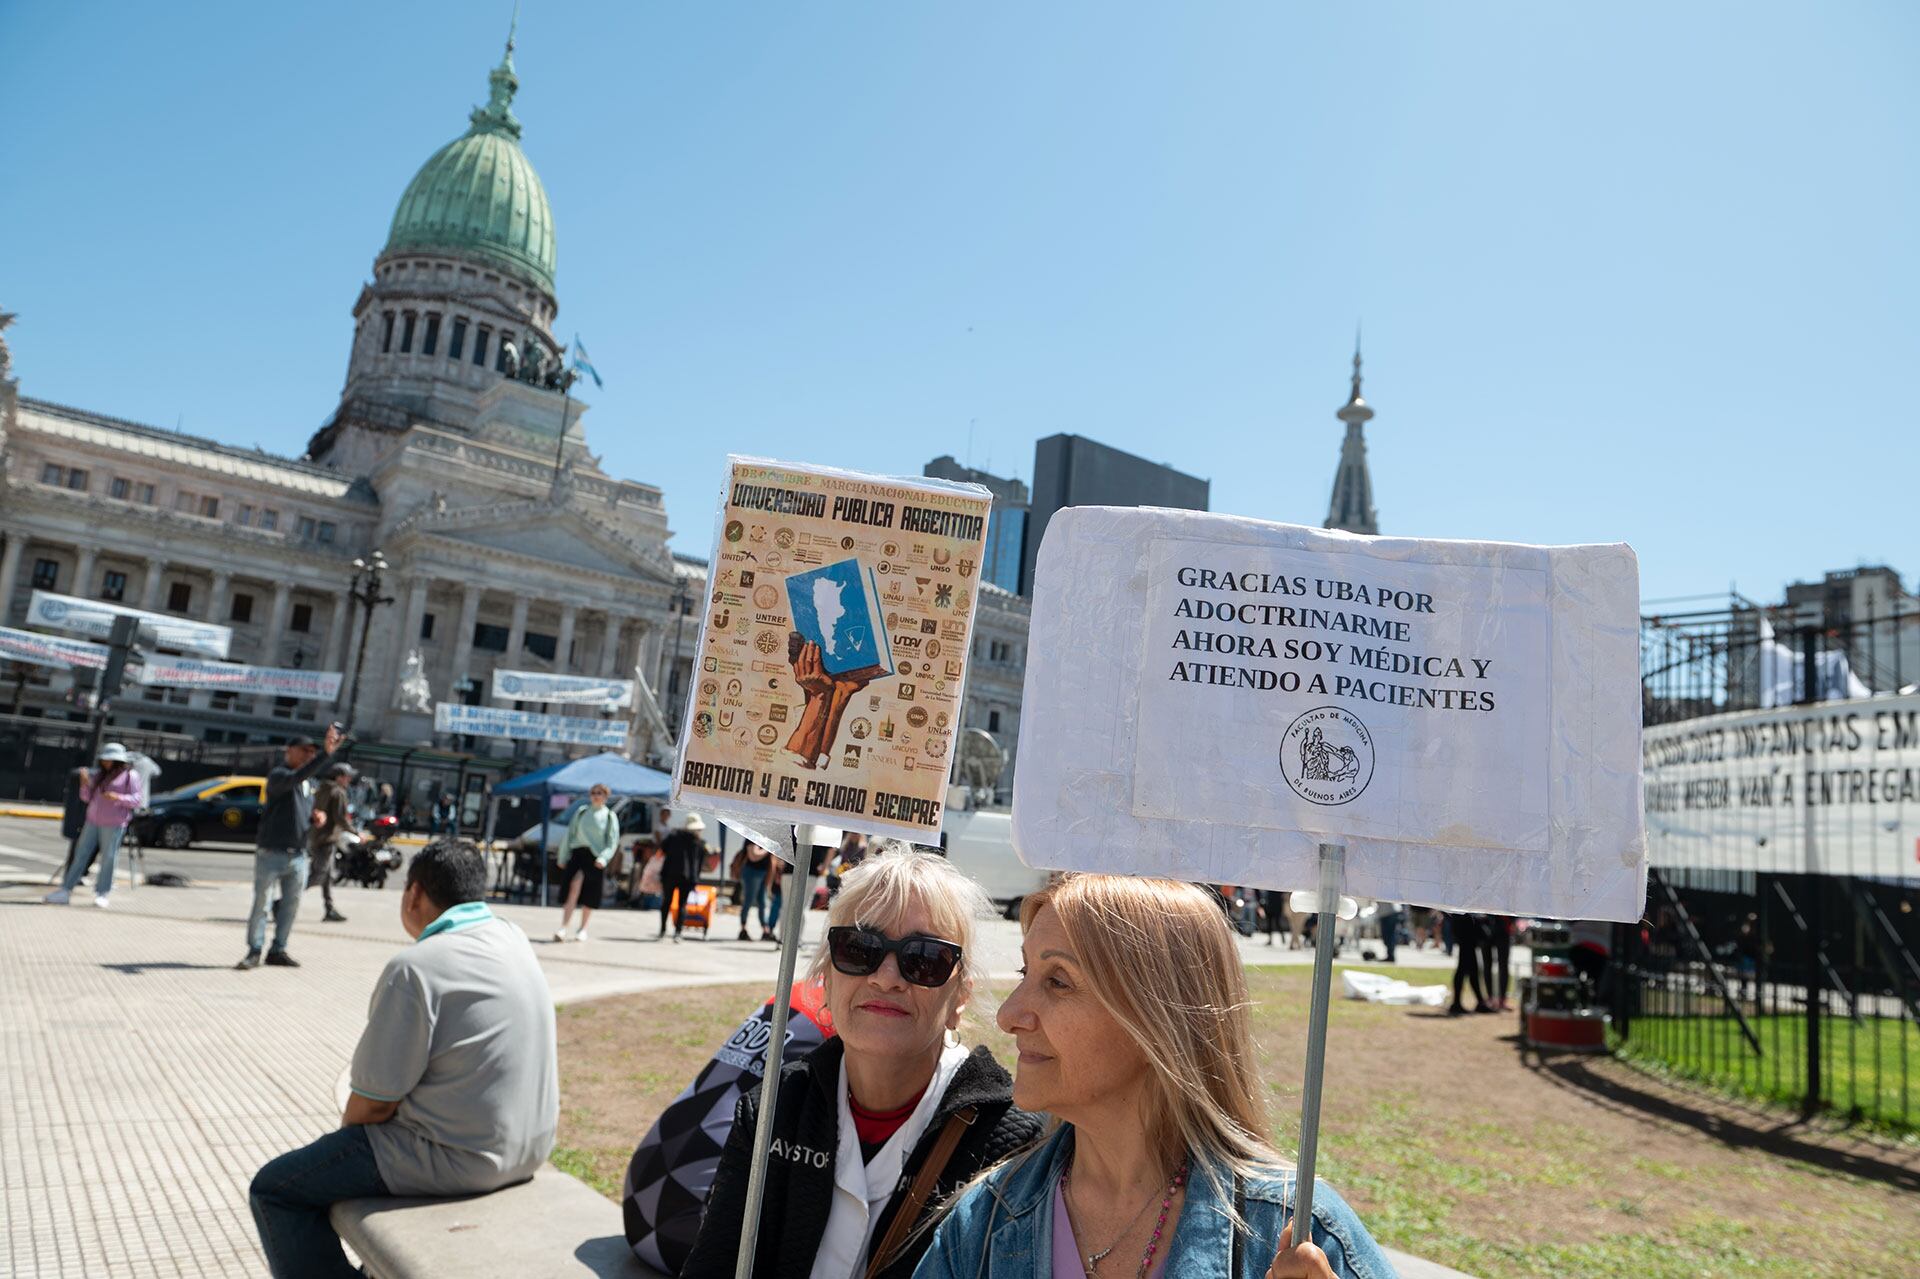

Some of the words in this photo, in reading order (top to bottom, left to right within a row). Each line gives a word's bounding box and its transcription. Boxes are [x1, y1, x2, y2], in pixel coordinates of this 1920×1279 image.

[821, 478, 867, 494] MARCHA
[870, 484, 928, 504] NACIONAL
[731, 484, 827, 518] UNIVERSIDAD
[832, 496, 895, 528] PUBLICA
[900, 506, 984, 541] ARGENTINA
[1177, 567, 1307, 596] GRACIAS
[1314, 579, 1372, 606] UBA
[1377, 588, 1436, 614] POR
[755, 613, 787, 624] UNTREF
[952, 609, 969, 618] UNC
[1173, 598, 1411, 643] ADOCTRINARME
[893, 634, 922, 648] UNDAV
[1171, 629, 1278, 658] AHORA
[1284, 639, 1343, 663] SOY
[1349, 645, 1465, 678] MÉDICA
[1471, 658, 1492, 679] Y
[1169, 661, 1301, 692] ATIENDO
[1306, 673, 1328, 695] A
[1334, 675, 1495, 712] PACIENTES
[1291, 713, 1325, 738] FACULTAD
[1329, 712, 1340, 720] DE
[1343, 716, 1368, 746] MEDICINA
[1735, 712, 1861, 758] INFANCIAS
[683, 760, 754, 795] GRATUITA
[777, 776, 799, 802] DE
[804, 780, 867, 814] CALIDAD
[873, 792, 940, 826] SIEMPRE
[1293, 778, 1303, 788] DE
[1303, 787, 1335, 801] BUENOS
[1339, 786, 1357, 800] AIRES
[1806, 768, 1920, 806] ENTREGA
